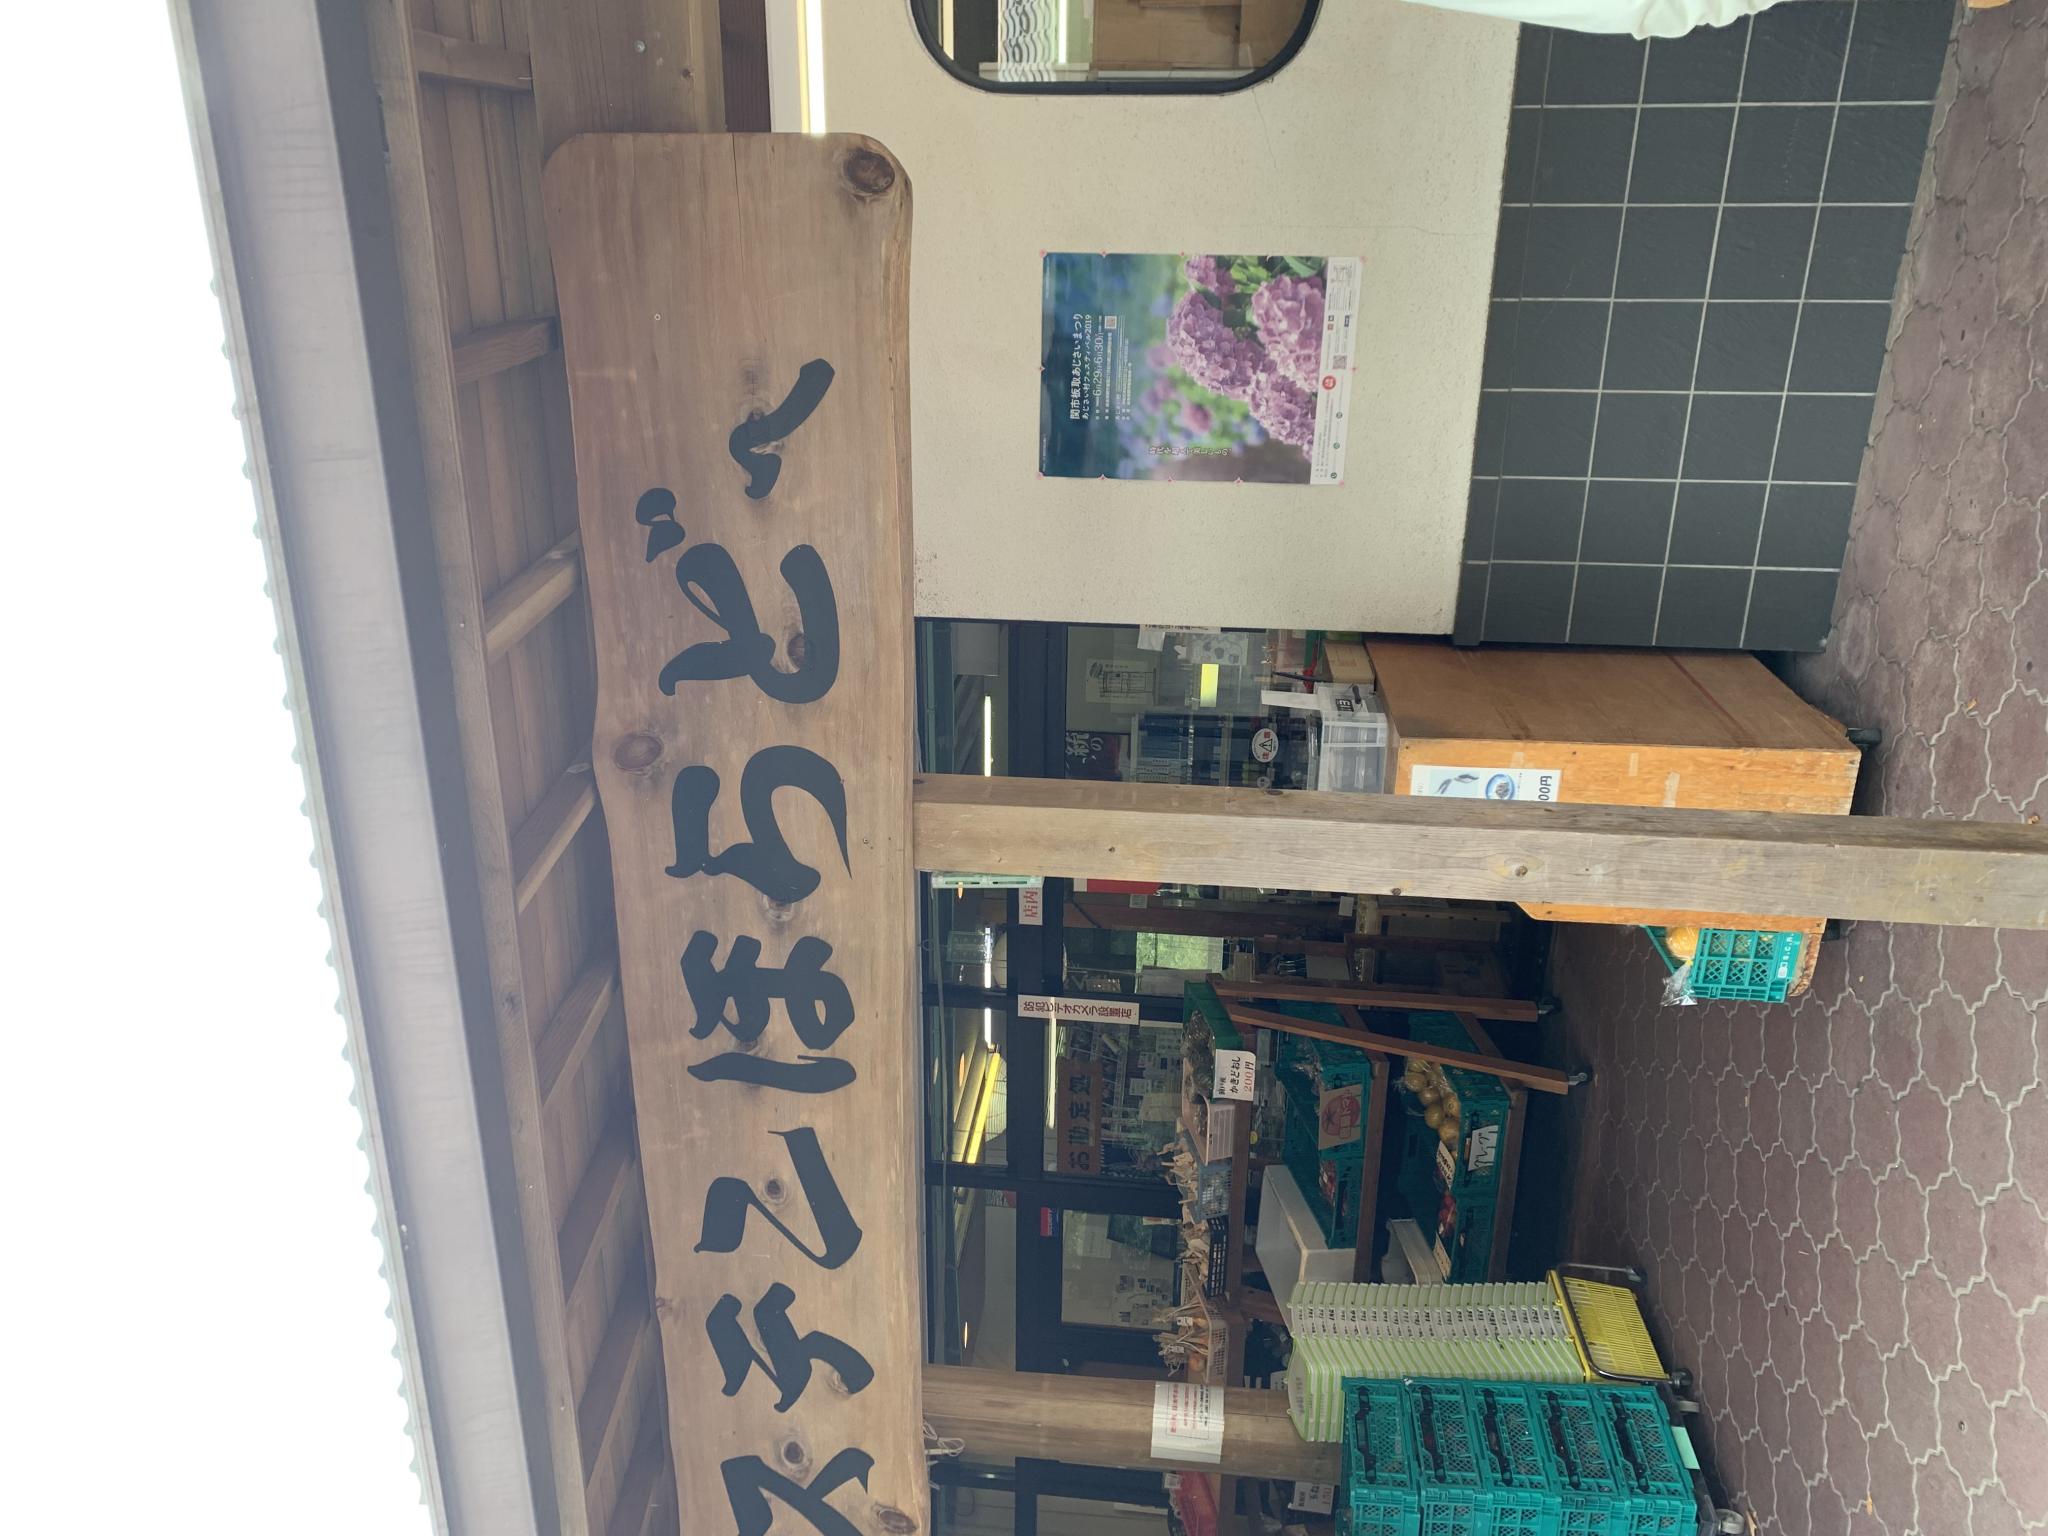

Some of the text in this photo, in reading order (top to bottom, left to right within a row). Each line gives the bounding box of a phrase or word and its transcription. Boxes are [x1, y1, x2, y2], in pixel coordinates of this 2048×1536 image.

[1069, 313, 1084, 420] 関市板取あじさいまつり
[1082, 314, 1092, 420] あじさい村フェスティバル2019
[1023, 887, 1038, 918] 店内
[1023, 1000, 1132, 1019] 防犯ビデオカメラ設置店
[1229, 1056, 1240, 1094] かきどおし
[1243, 1061, 1254, 1093] 200円
